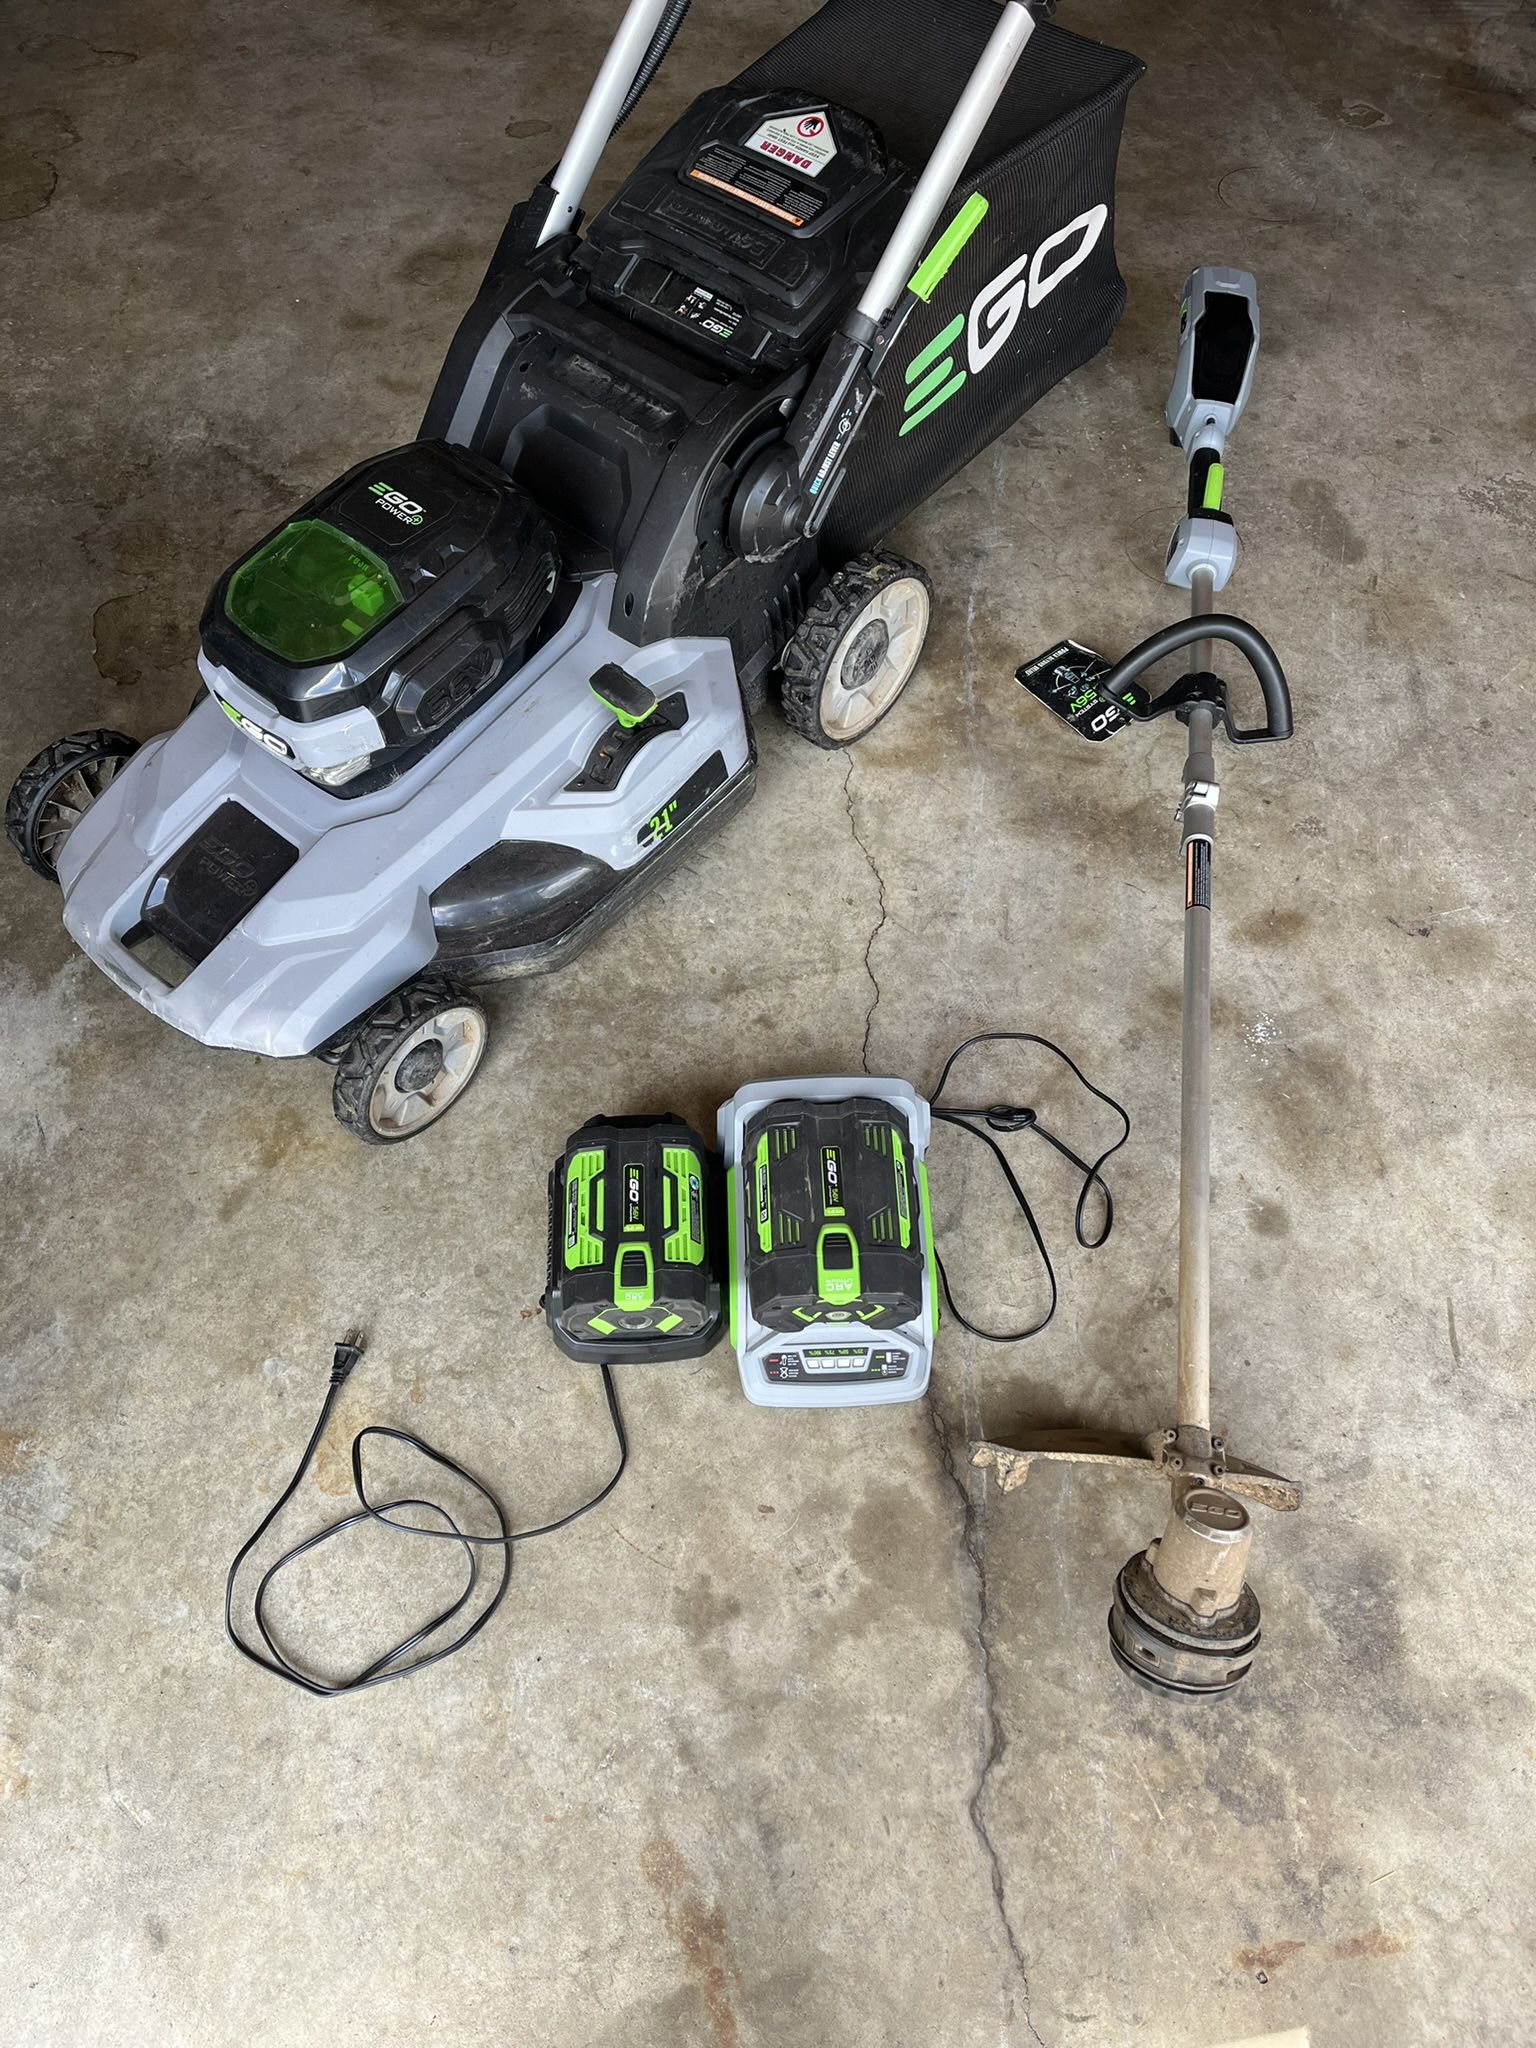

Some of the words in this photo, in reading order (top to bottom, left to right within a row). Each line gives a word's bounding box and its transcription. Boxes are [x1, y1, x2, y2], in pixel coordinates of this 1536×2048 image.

[760, 140, 813, 169] DANGER
[702, 319, 734, 339] EGO
[898, 203, 1108, 437] EGO
[809, 476, 823, 495] QUICK
[817, 456, 833, 479] ADJUST
[827, 440, 841, 459] LEVER
[368, 482, 424, 515] EGO
[1053, 646, 1070, 658] POWER
[1070, 689, 1098, 713] 56V
[221, 700, 288, 756] EGO
[826, 1148, 838, 1185] EGO
[629, 1167, 640, 1202] EGO
[825, 1282, 852, 1291] ARC
